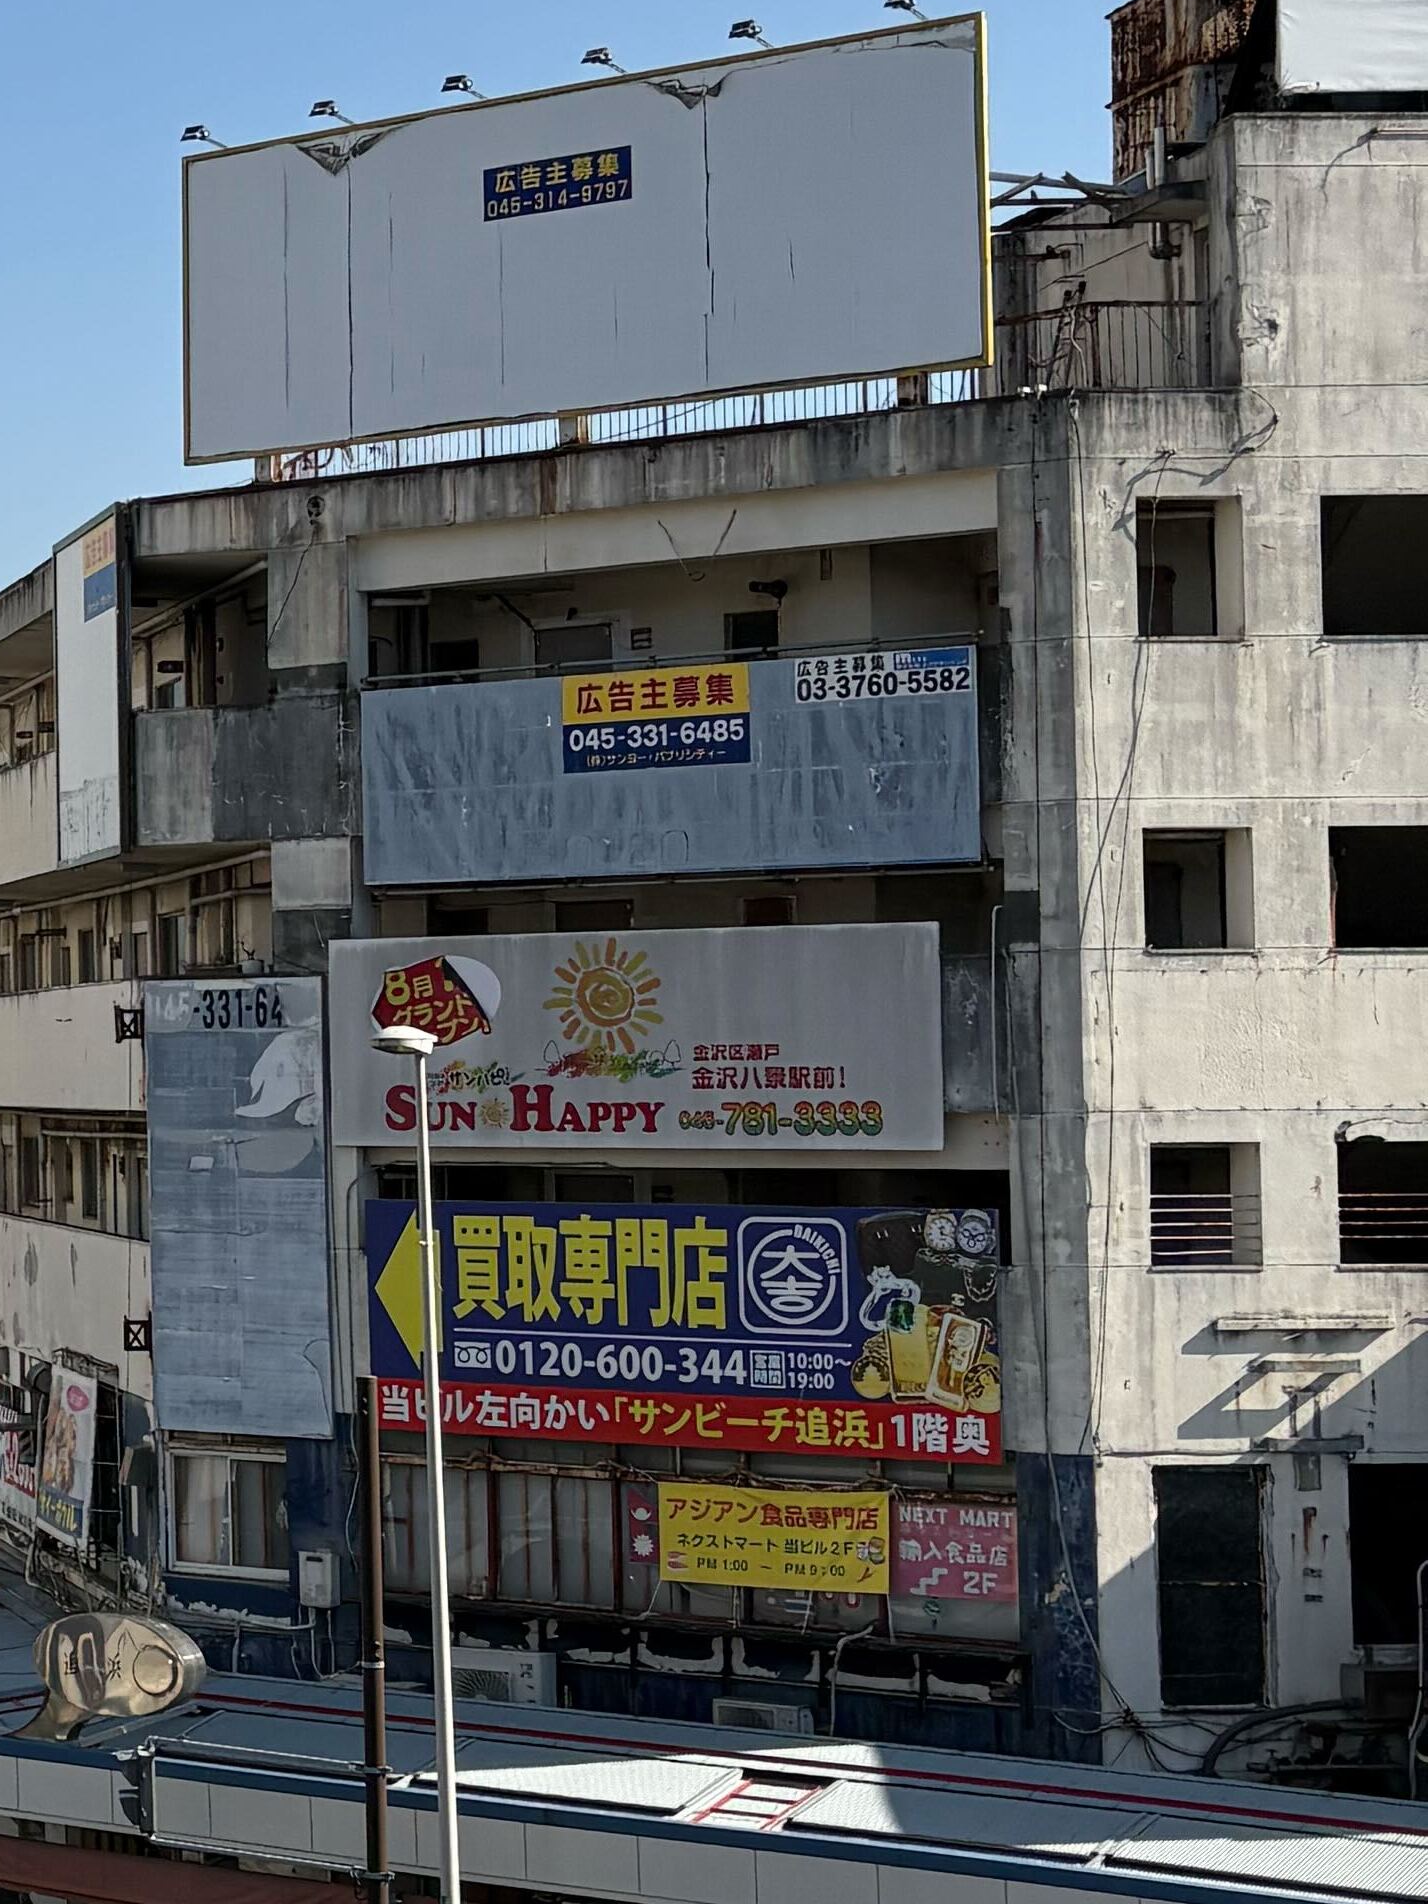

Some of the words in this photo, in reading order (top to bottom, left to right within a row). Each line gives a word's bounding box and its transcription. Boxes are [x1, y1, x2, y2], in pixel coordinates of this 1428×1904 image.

[495, 152, 620, 193] 広告主募集
[487, 180, 628, 218] 045-314-9797
[797, 654, 886, 677] 広告主募集
[577, 673, 735, 715] 広告主募集
[796, 666, 971, 703] 03-3760-5582
[569, 718, 745, 752] 045-331-6485
[385, 970, 434, 1006] 8月
[693, 1044, 781, 1062] 金沢区瀬戸
[691, 1066, 847, 1091] 金沢八景駅前!
[509, 1084, 665, 1133] HAPPY
[792, 1224, 841, 1276] DAIKICHI
[452, 1213, 728, 1330] 買取専門店
[495, 1339, 747, 1386] 0120-600-344
[788, 1370, 835, 1390] 19:00
[666, 1498, 880, 1531] アジアン食品専門店
[899, 1505, 949, 1527] NEXT
[959, 1508, 1014, 1529] MART
[677, 1534, 778, 1553] ネクストマート
[898, 1539, 1009, 1567] 輸入食品店
[963, 1570, 999, 1595] 2F
